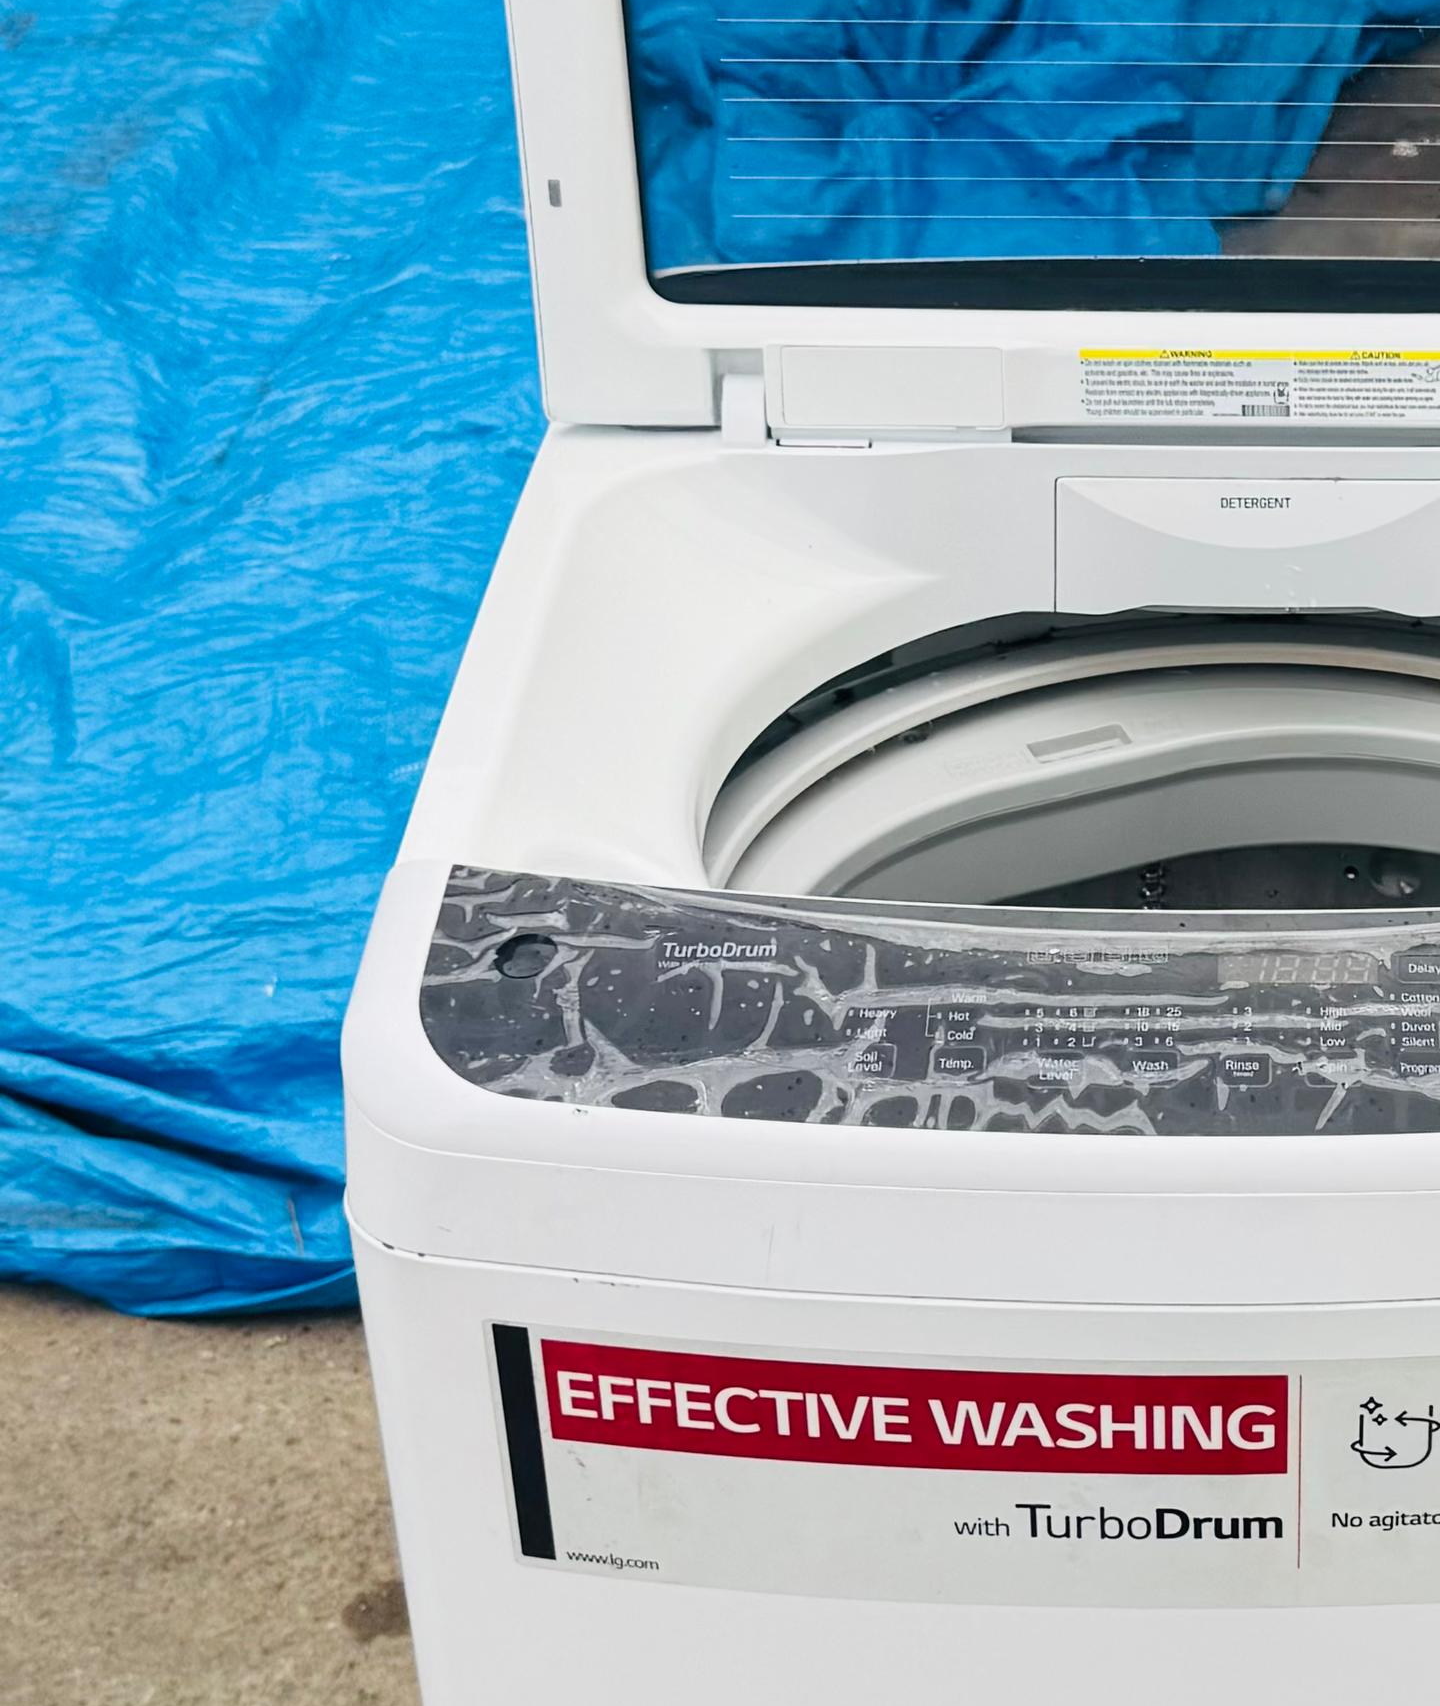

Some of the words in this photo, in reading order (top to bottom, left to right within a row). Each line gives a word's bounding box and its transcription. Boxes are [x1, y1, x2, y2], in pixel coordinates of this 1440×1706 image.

[1170, 351, 1213, 359] WARNING
[1220, 496, 1291, 510] DETERGENT
[663, 942, 777, 958] TurboDrum
[951, 993, 987, 1003] Warm
[859, 1008, 897, 1019] Heavy
[948, 1011, 970, 1022] Hot
[1320, 1006, 1347, 1019] High
[1401, 1007, 1432, 1017] Wool
[1320, 1022, 1342, 1032] Mid
[1401, 1022, 1436, 1032] Duvet
[947, 1030, 974, 1041] Cold
[1067, 1037, 1076, 1047] 2
[1319, 1037, 1346, 1047] Low
[1401, 1037, 1436, 1047] Silent
[855, 1051, 878, 1063] Soil
[848, 1061, 882, 1072] Level
[938, 1057, 974, 1071] Temp.
[1132, 1060, 1169, 1071] Wash
[1225, 1059, 1260, 1071] Rinse
[557, 1370, 913, 1444] EFFECTIVE
[930, 1399, 1277, 1450] WASHING
[954, 1513, 1011, 1539] with
[1015, 1503, 1284, 1542] TurboDrum
[1332, 1510, 1363, 1529] No
[566, 1549, 660, 1573] www.lg.com
